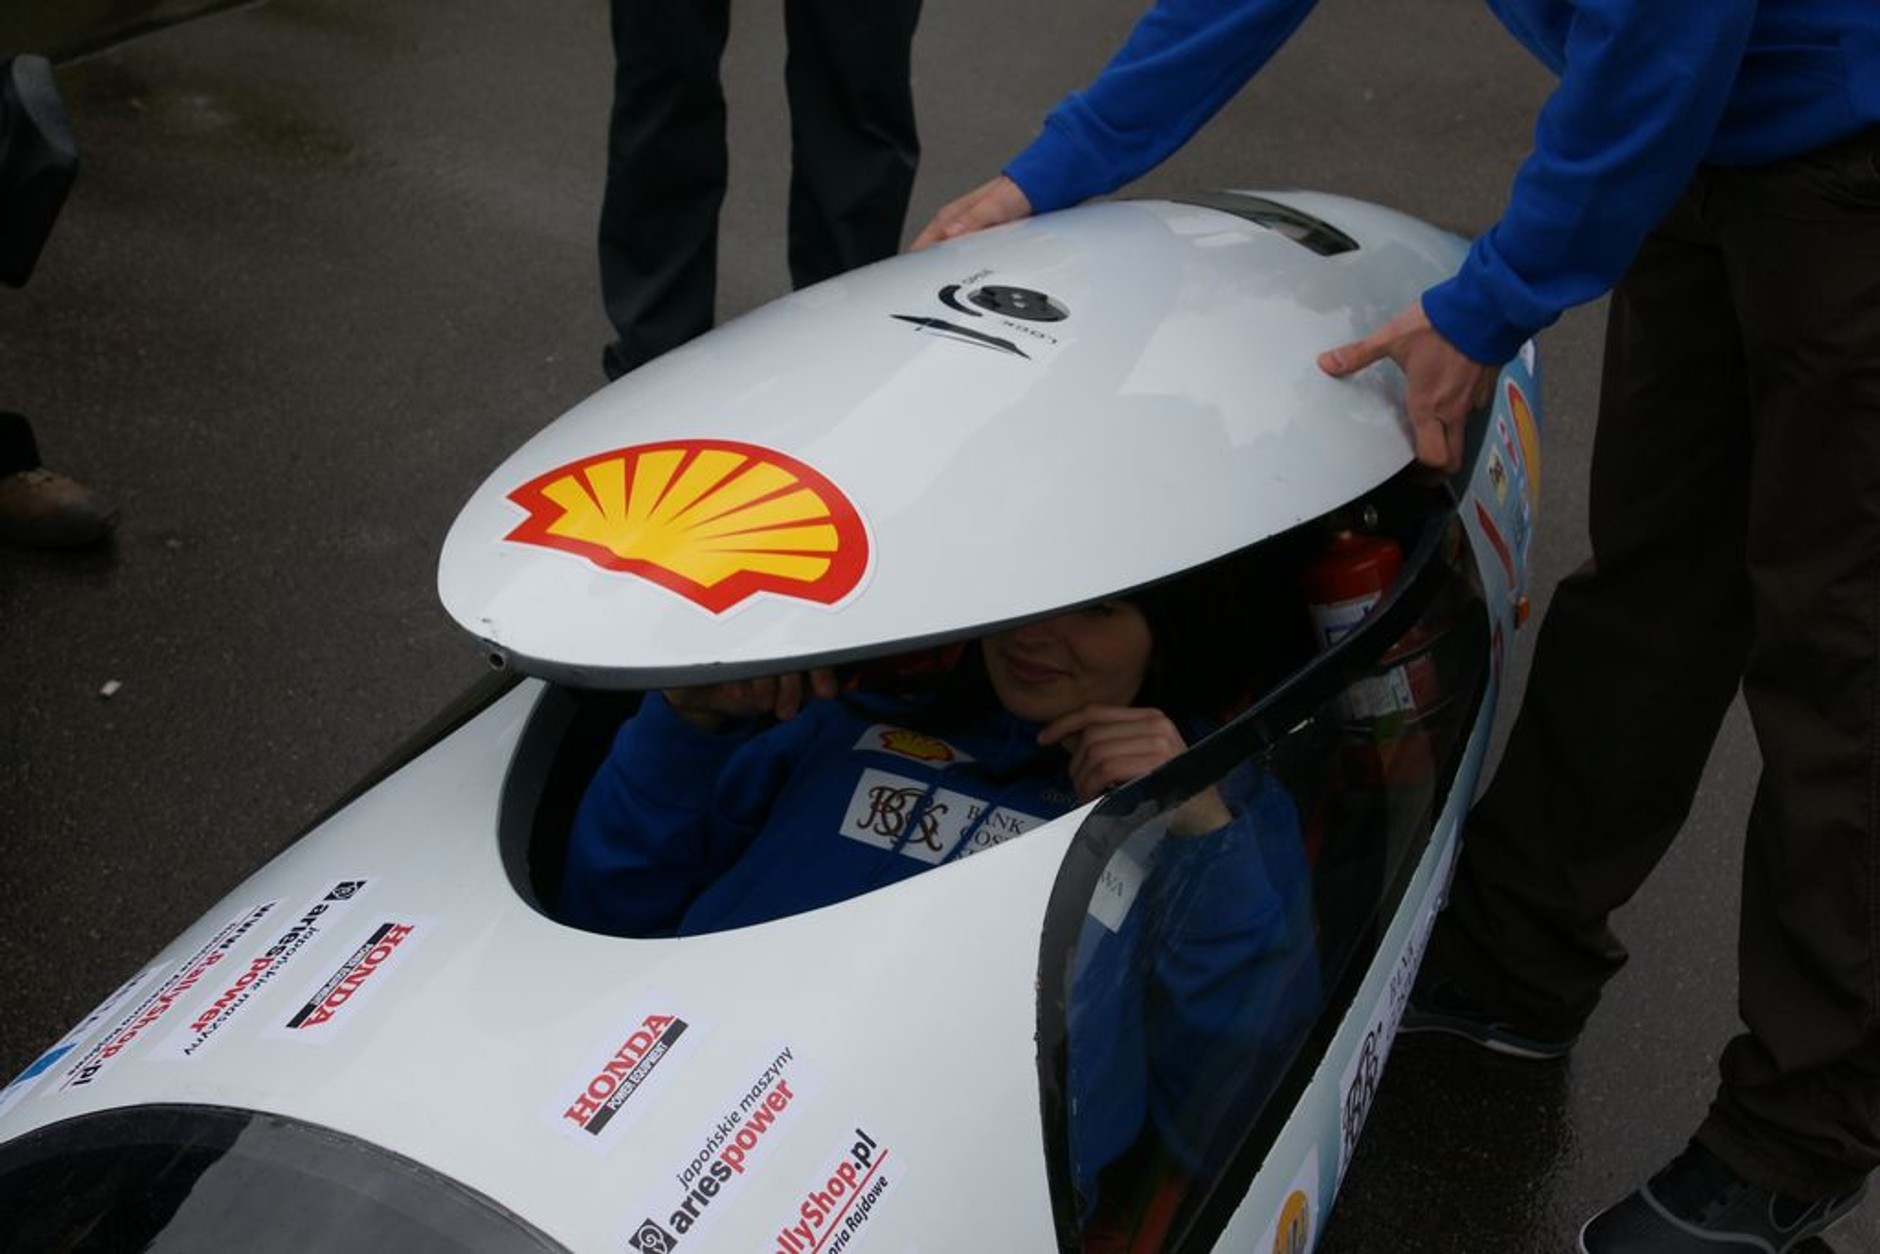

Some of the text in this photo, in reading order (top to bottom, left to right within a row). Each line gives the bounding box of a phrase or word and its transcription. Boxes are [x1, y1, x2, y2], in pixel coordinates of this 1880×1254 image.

[72, 901, 279, 1086] www.RallyShop.pl
[190, 903, 330, 1033] ariespower
[301, 923, 415, 1030] HONDA
[563, 1013, 675, 1127] HONDA
[676, 1046, 794, 1191] japońskie maszyny
[669, 1078, 795, 1235] ariespower
[774, 1127, 878, 1254] llyShop.pl
[844, 1175, 889, 1233] Rajdowe
